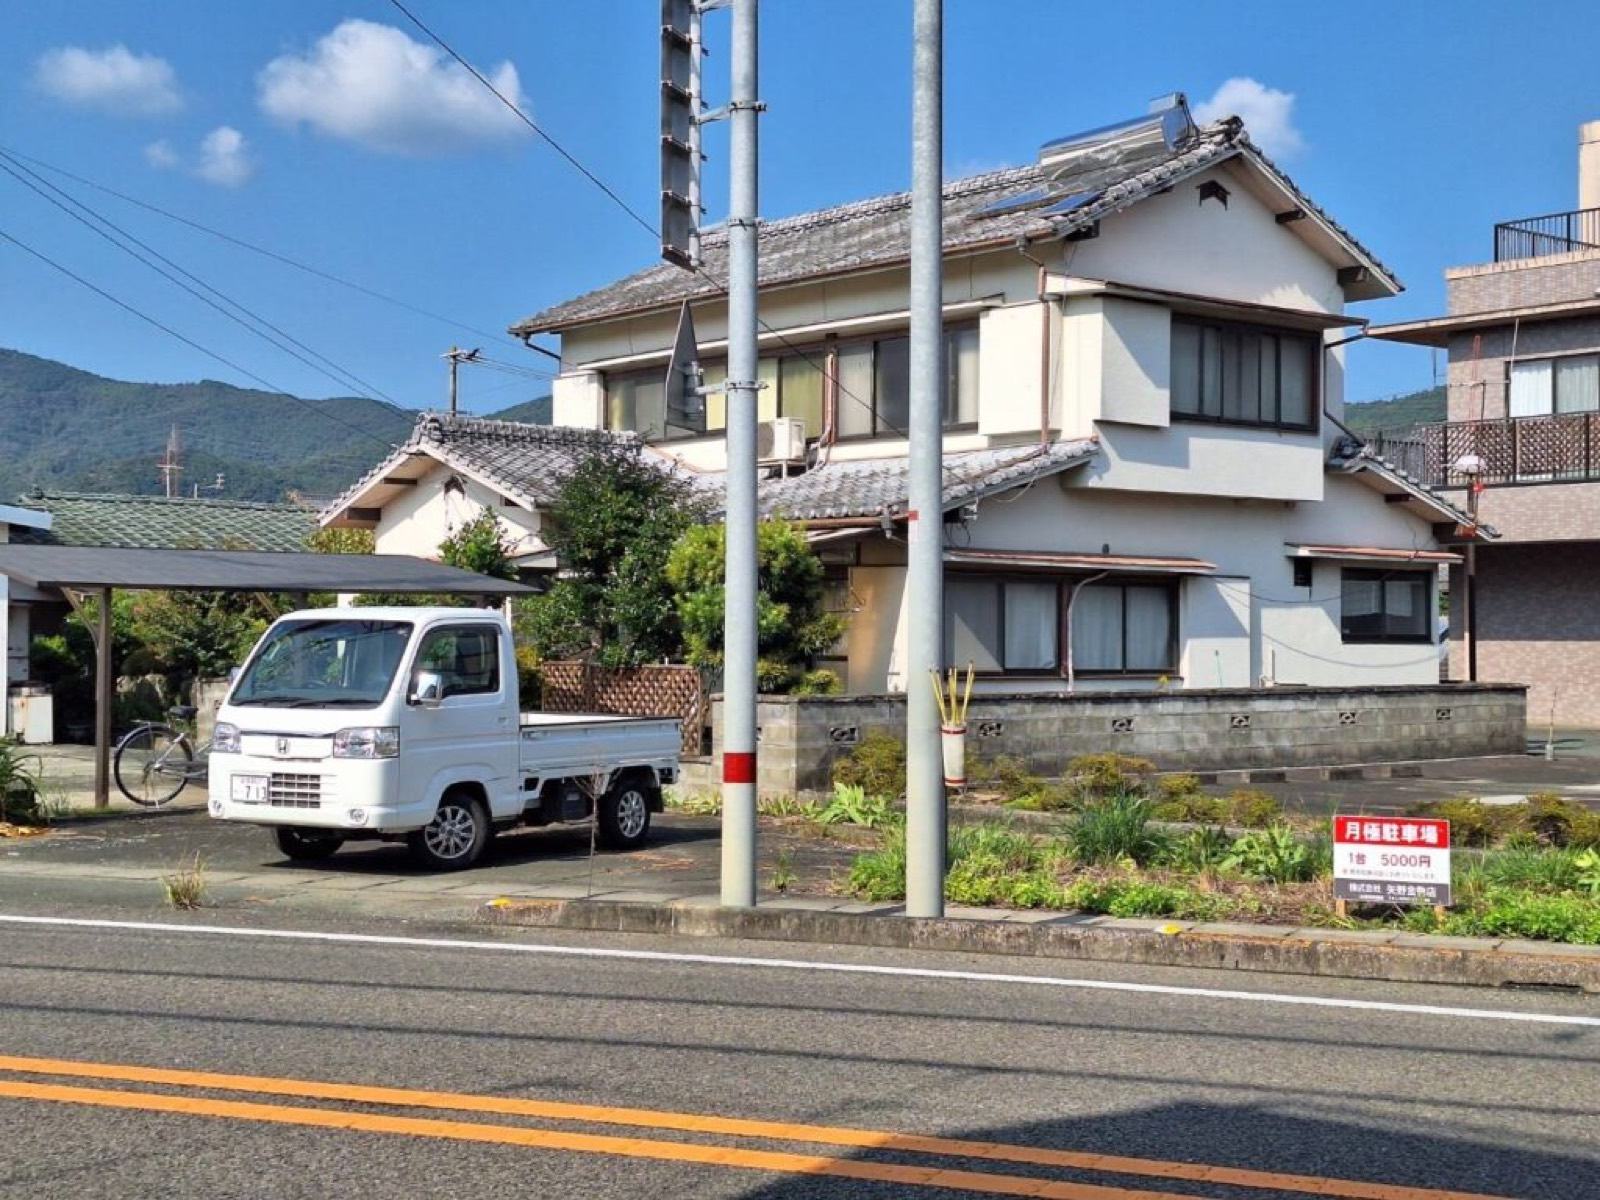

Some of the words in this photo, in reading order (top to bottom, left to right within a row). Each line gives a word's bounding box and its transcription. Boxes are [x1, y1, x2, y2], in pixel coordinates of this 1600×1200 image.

[1345, 821, 1438, 844] 月極駐車場
[1349, 851, 1366, 865] 1台
[1381, 853, 1431, 868] 5000円
